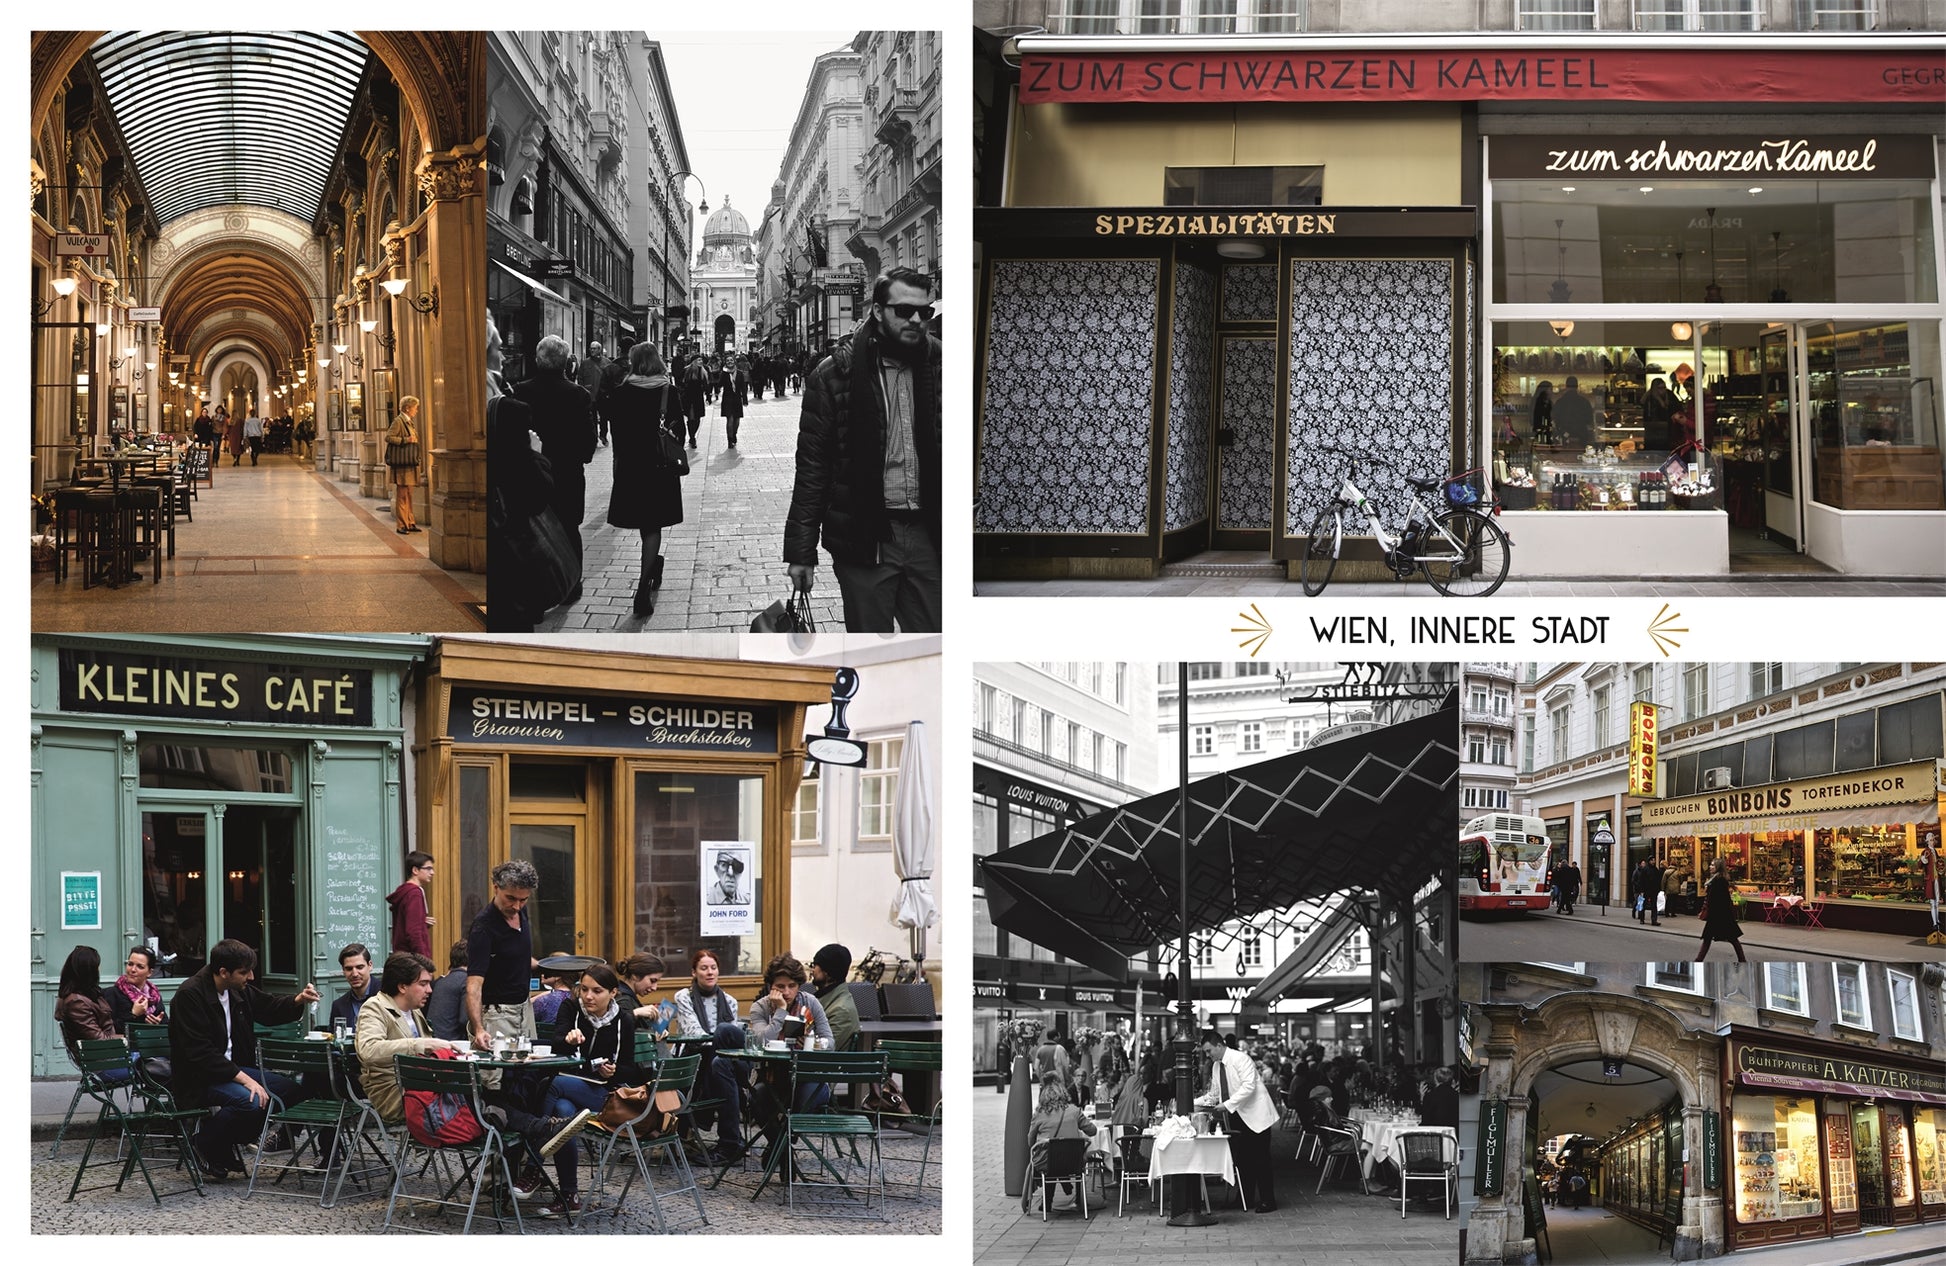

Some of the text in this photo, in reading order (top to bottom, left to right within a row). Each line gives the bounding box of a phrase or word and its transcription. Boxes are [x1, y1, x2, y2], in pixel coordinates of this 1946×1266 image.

[1028, 58, 1609, 92] ZUM SCHWARZEN KAMEEL
[1546, 139, 1877, 171] zum schwarzen Kameel
[1095, 211, 1337, 235] SPEZIALITÄTEN
[66, 236, 100, 247] VULCANO
[78, 663, 354, 715] KLEINES CAFÉ
[1322, 684, 1400, 698] STIEBITZ
[472, 697, 595, 722] STEMPEL
[629, 706, 753, 730] SCHILDER
[472, 718, 752, 748] Gravuren Buchstaben
[1641, 705, 1654, 793] BONBONS
[1007, 785, 1069, 812] LOUIS VUITTON
[1650, 777, 1905, 817] LEBKUCHEN BONBONS TORTENDEKOR
[1692, 823, 1719, 834] ALLES
[1751, 820, 1769, 831] DIE
[1776, 816, 1818, 829] TORTE
[66, 890, 96, 902] BITTE
[68, 901, 97, 913] PSSST!
[709, 910, 728, 918] JOHN
[1075, 992, 1114, 1002] LOUIS VUITTON
[1609, 1065, 1616, 1074] 5
[1748, 1056, 1820, 1073] BUNTPAPIERE
[1749, 1073, 1804, 1087] Vienna Souvenirs
[1485, 1108, 1497, 1188] FIGLMÜLLER
